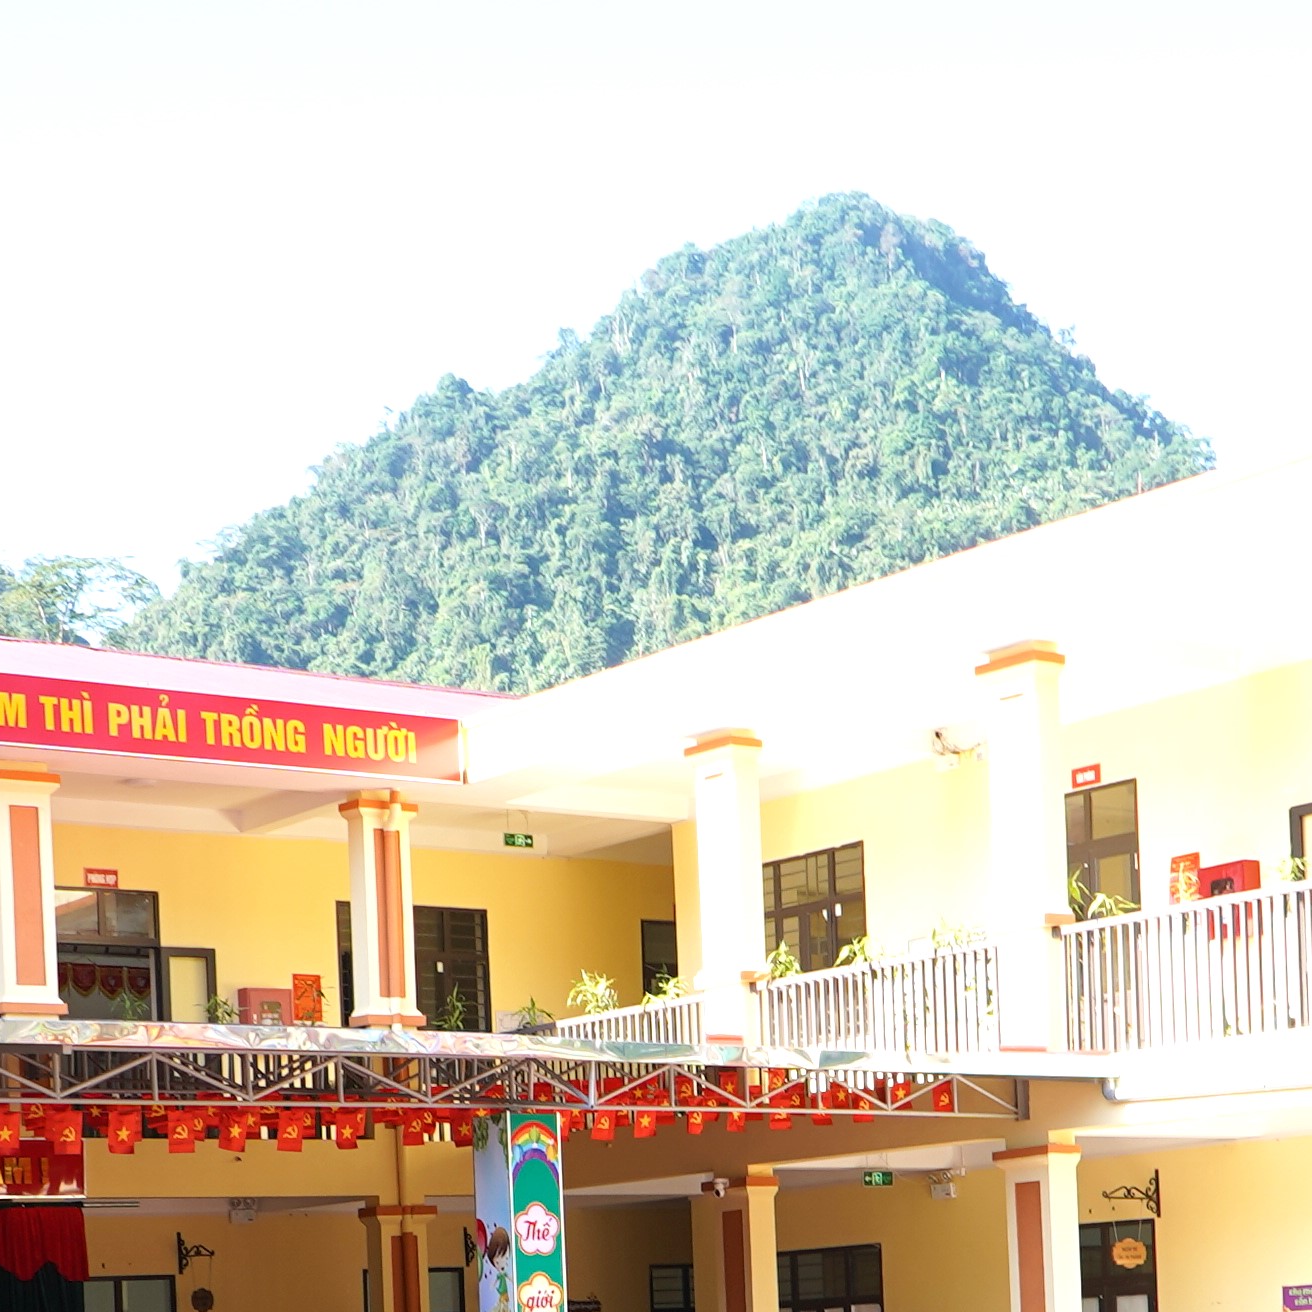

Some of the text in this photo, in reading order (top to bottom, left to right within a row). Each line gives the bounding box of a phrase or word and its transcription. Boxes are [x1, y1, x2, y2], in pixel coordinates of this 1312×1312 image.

[38, 694, 94, 735] THÌ
[107, 694, 188, 744] PHẢI
[200, 704, 307, 755] TRỒNG
[322, 724, 418, 763] NGƯỜI
[522, 1214, 556, 1242] Thế
